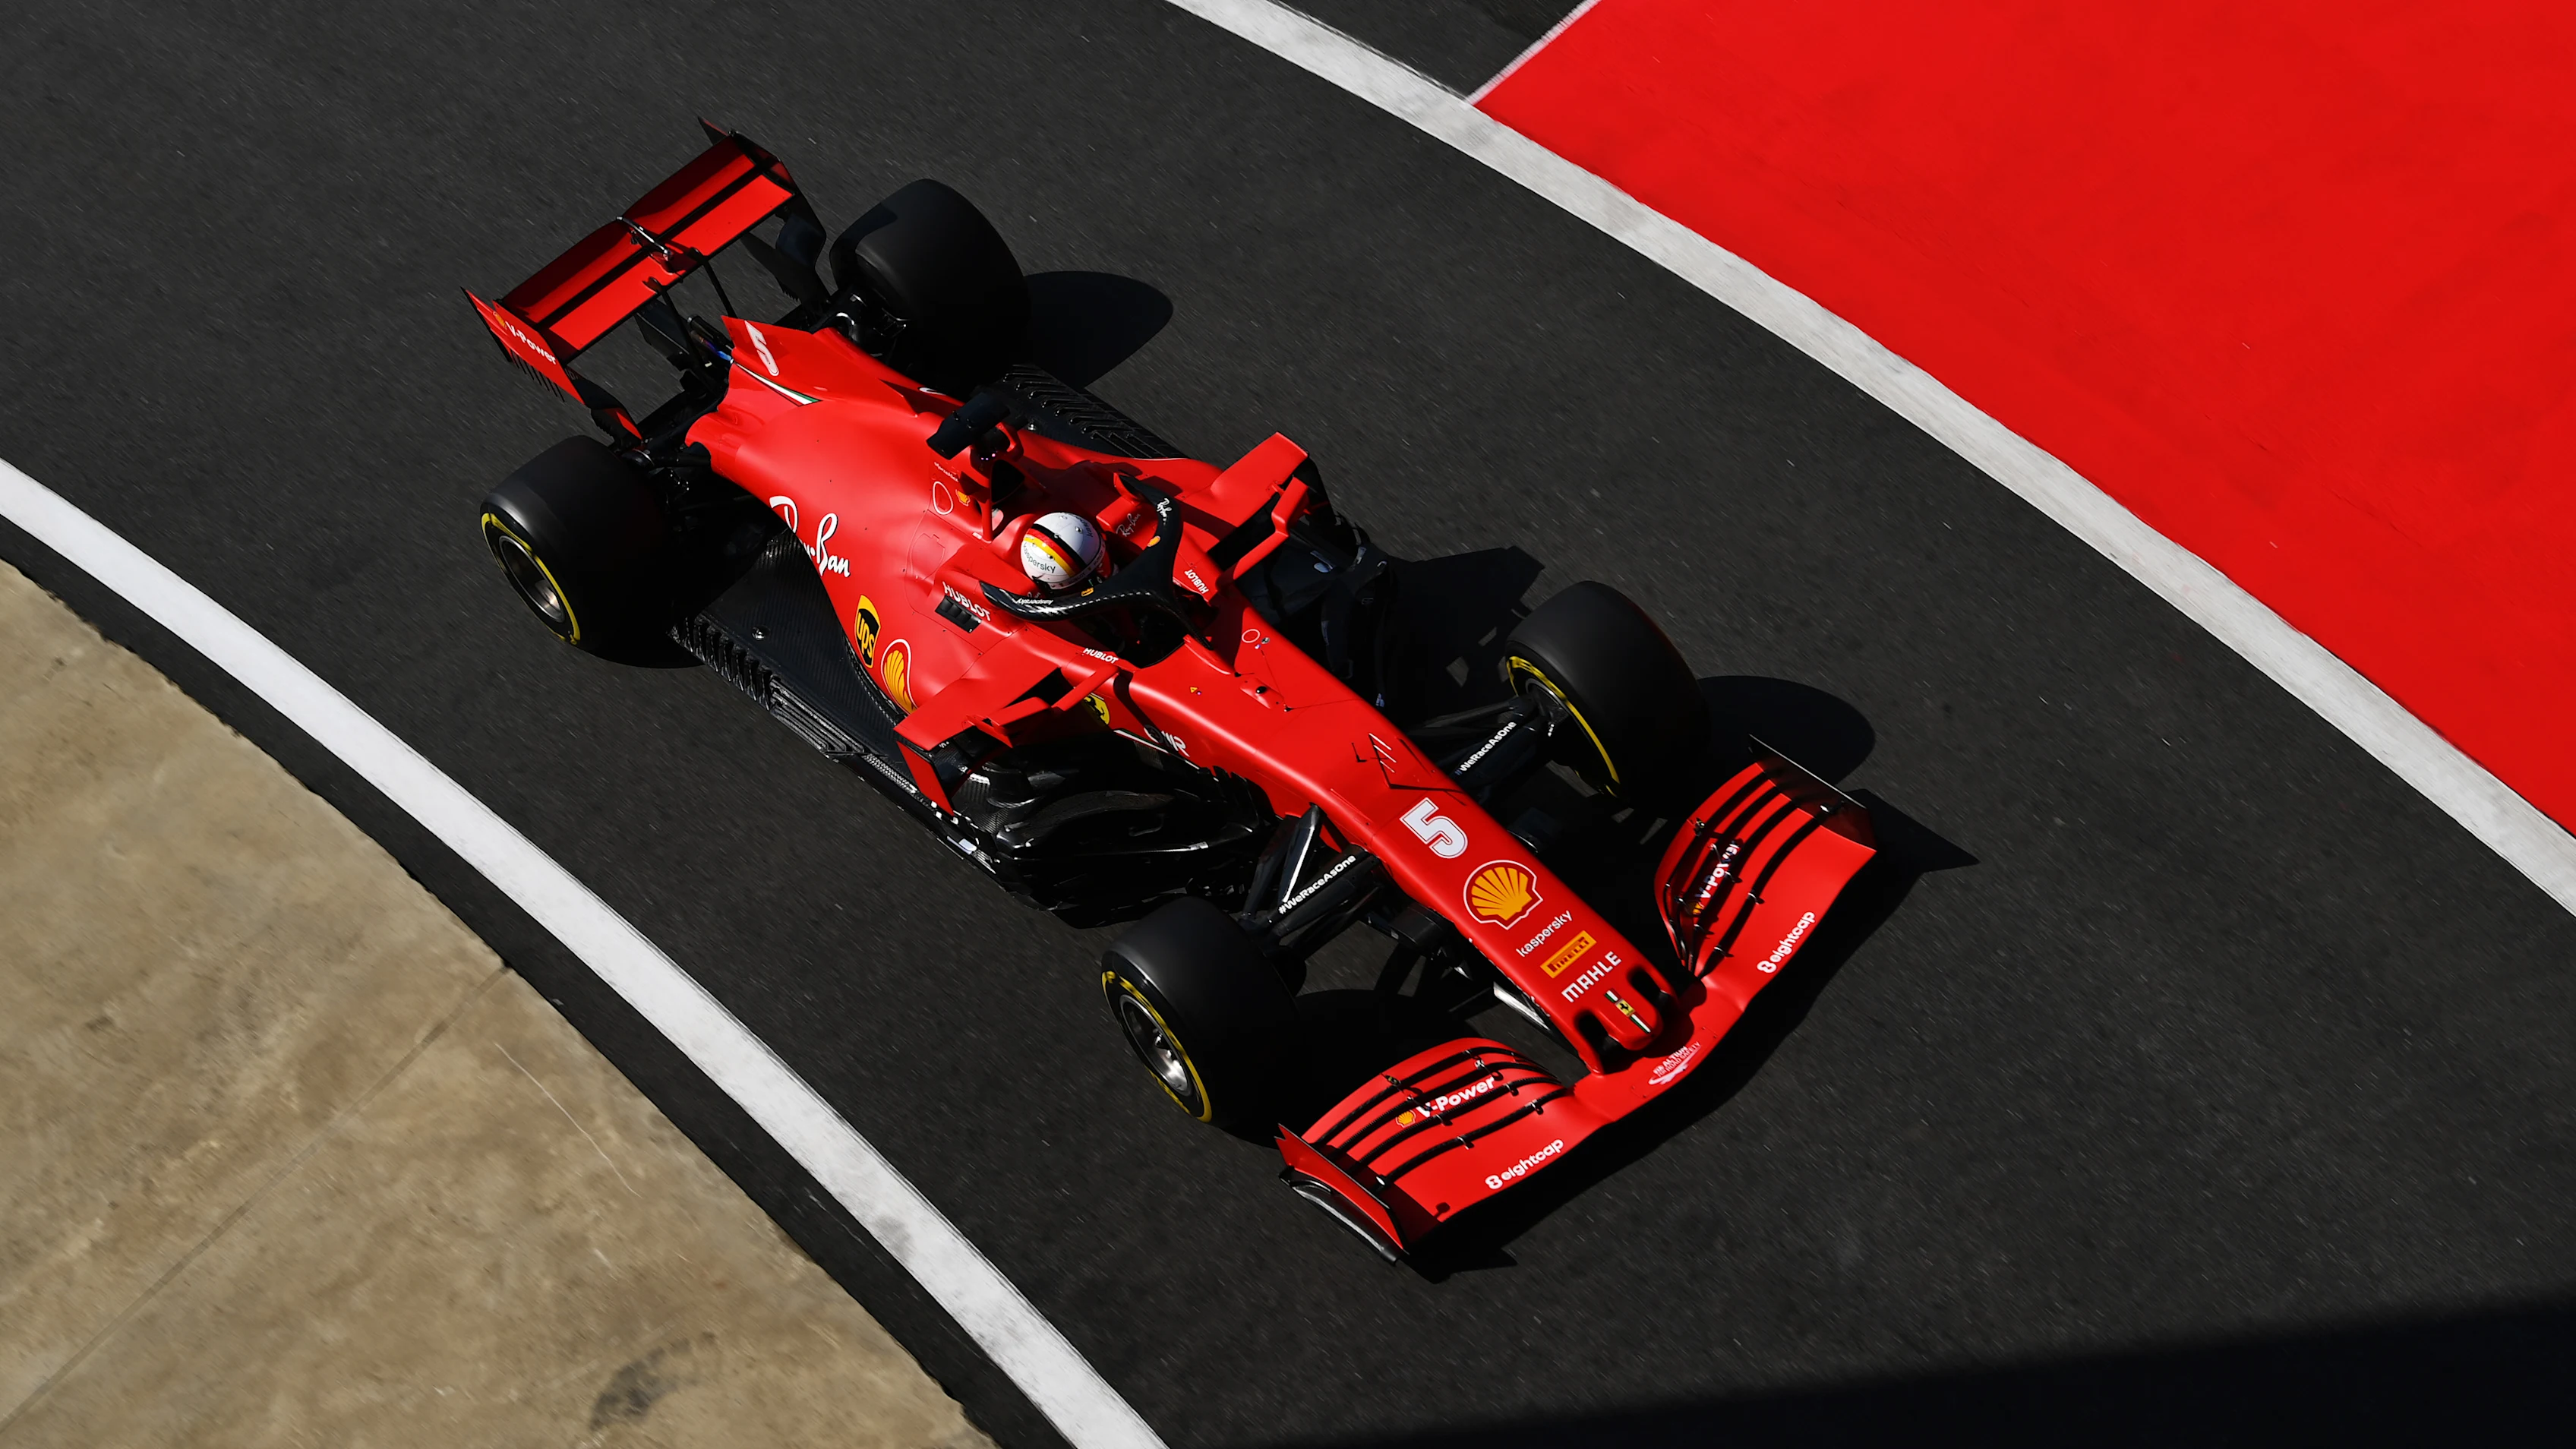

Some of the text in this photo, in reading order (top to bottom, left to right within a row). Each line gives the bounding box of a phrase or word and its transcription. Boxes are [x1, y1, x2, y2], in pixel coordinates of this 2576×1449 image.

[505, 320, 556, 365] V-Power
[744, 320, 780, 377] 5
[942, 581, 991, 621] HUBLOT
[1184, 569, 1210, 594] HUBLOT
[1083, 648, 1119, 664] HUBLOT
[1400, 797, 1468, 859] 5
[1278, 855, 1356, 914] #WeRaceAsOne
[1516, 910, 1573, 958] kaspersky
[1546, 936, 1590, 973] PIRELLI
[1561, 951, 1622, 1003] MAHLE
[1416, 1076, 1495, 1118] V-Power
